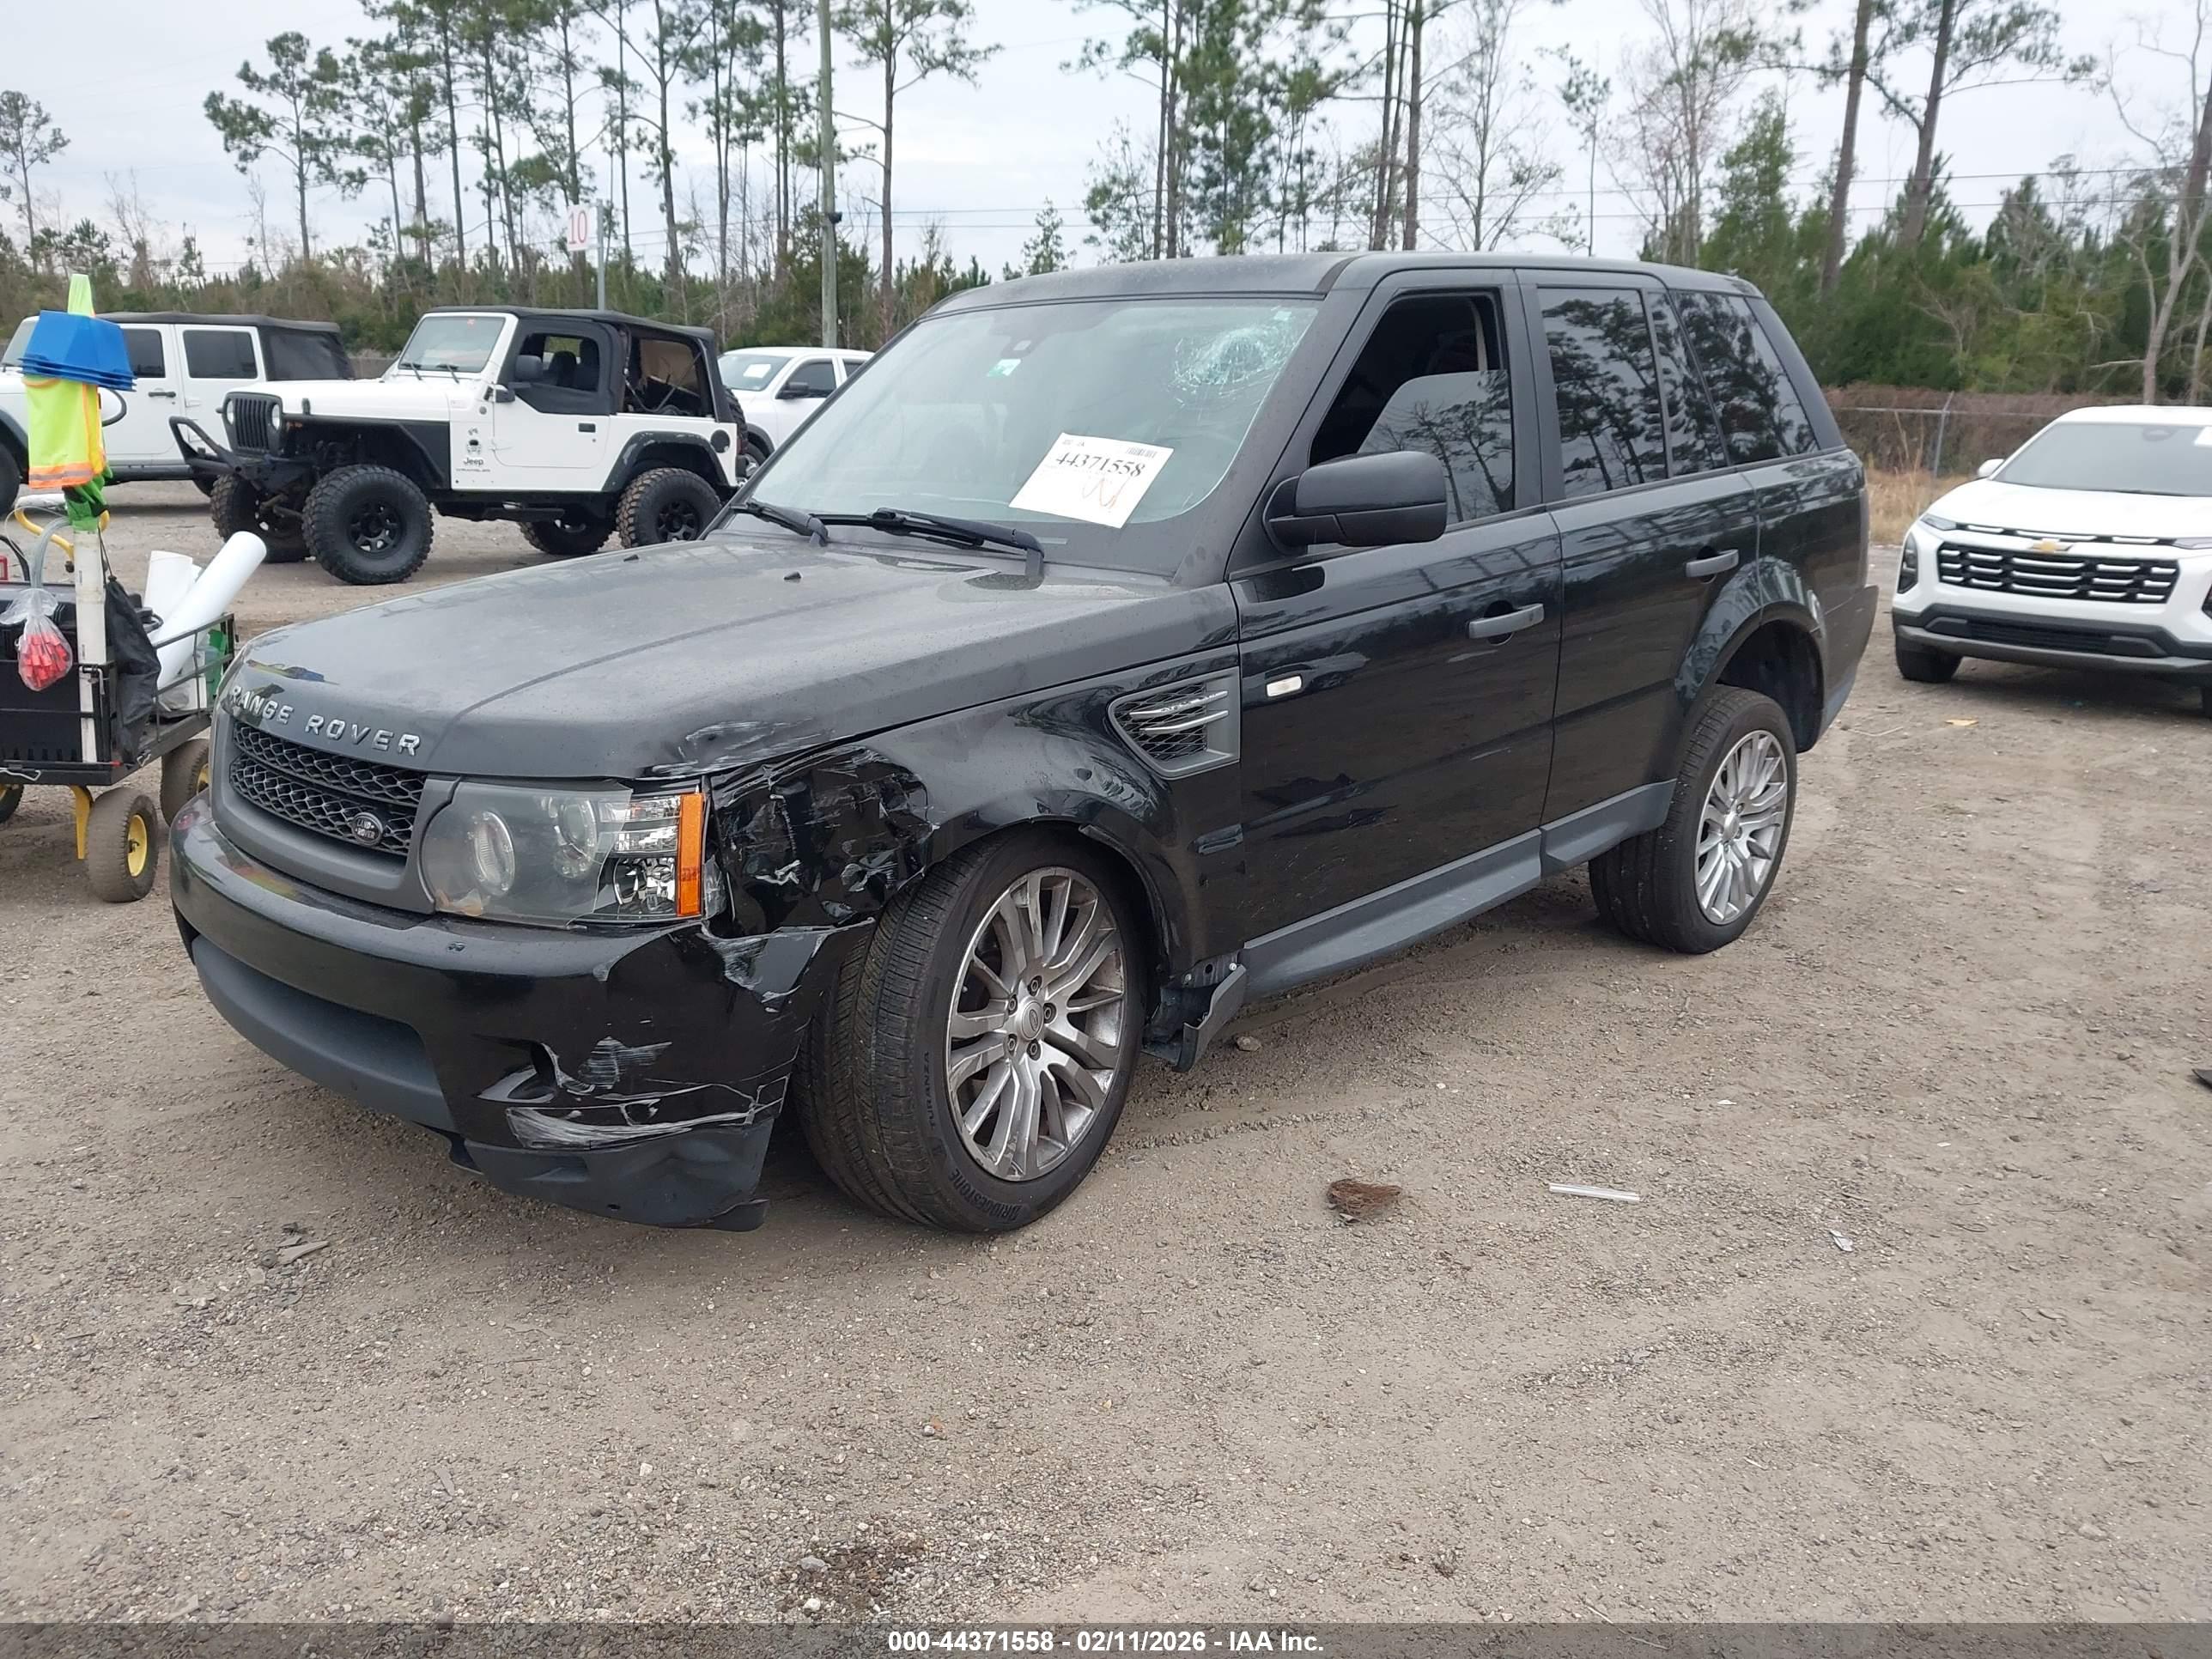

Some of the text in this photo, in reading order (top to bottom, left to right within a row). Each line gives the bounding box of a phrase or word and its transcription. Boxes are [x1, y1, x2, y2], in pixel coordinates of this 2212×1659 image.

[568, 210, 588, 244] 10
[463, 457, 484, 466] Jeep
[1056, 452, 1146, 477] 44371558
[229, 684, 422, 757] RANGE ROVER
[922, 1051, 937, 1128] TURANZA
[948, 1168, 1023, 1221] BRIDGESTONE
